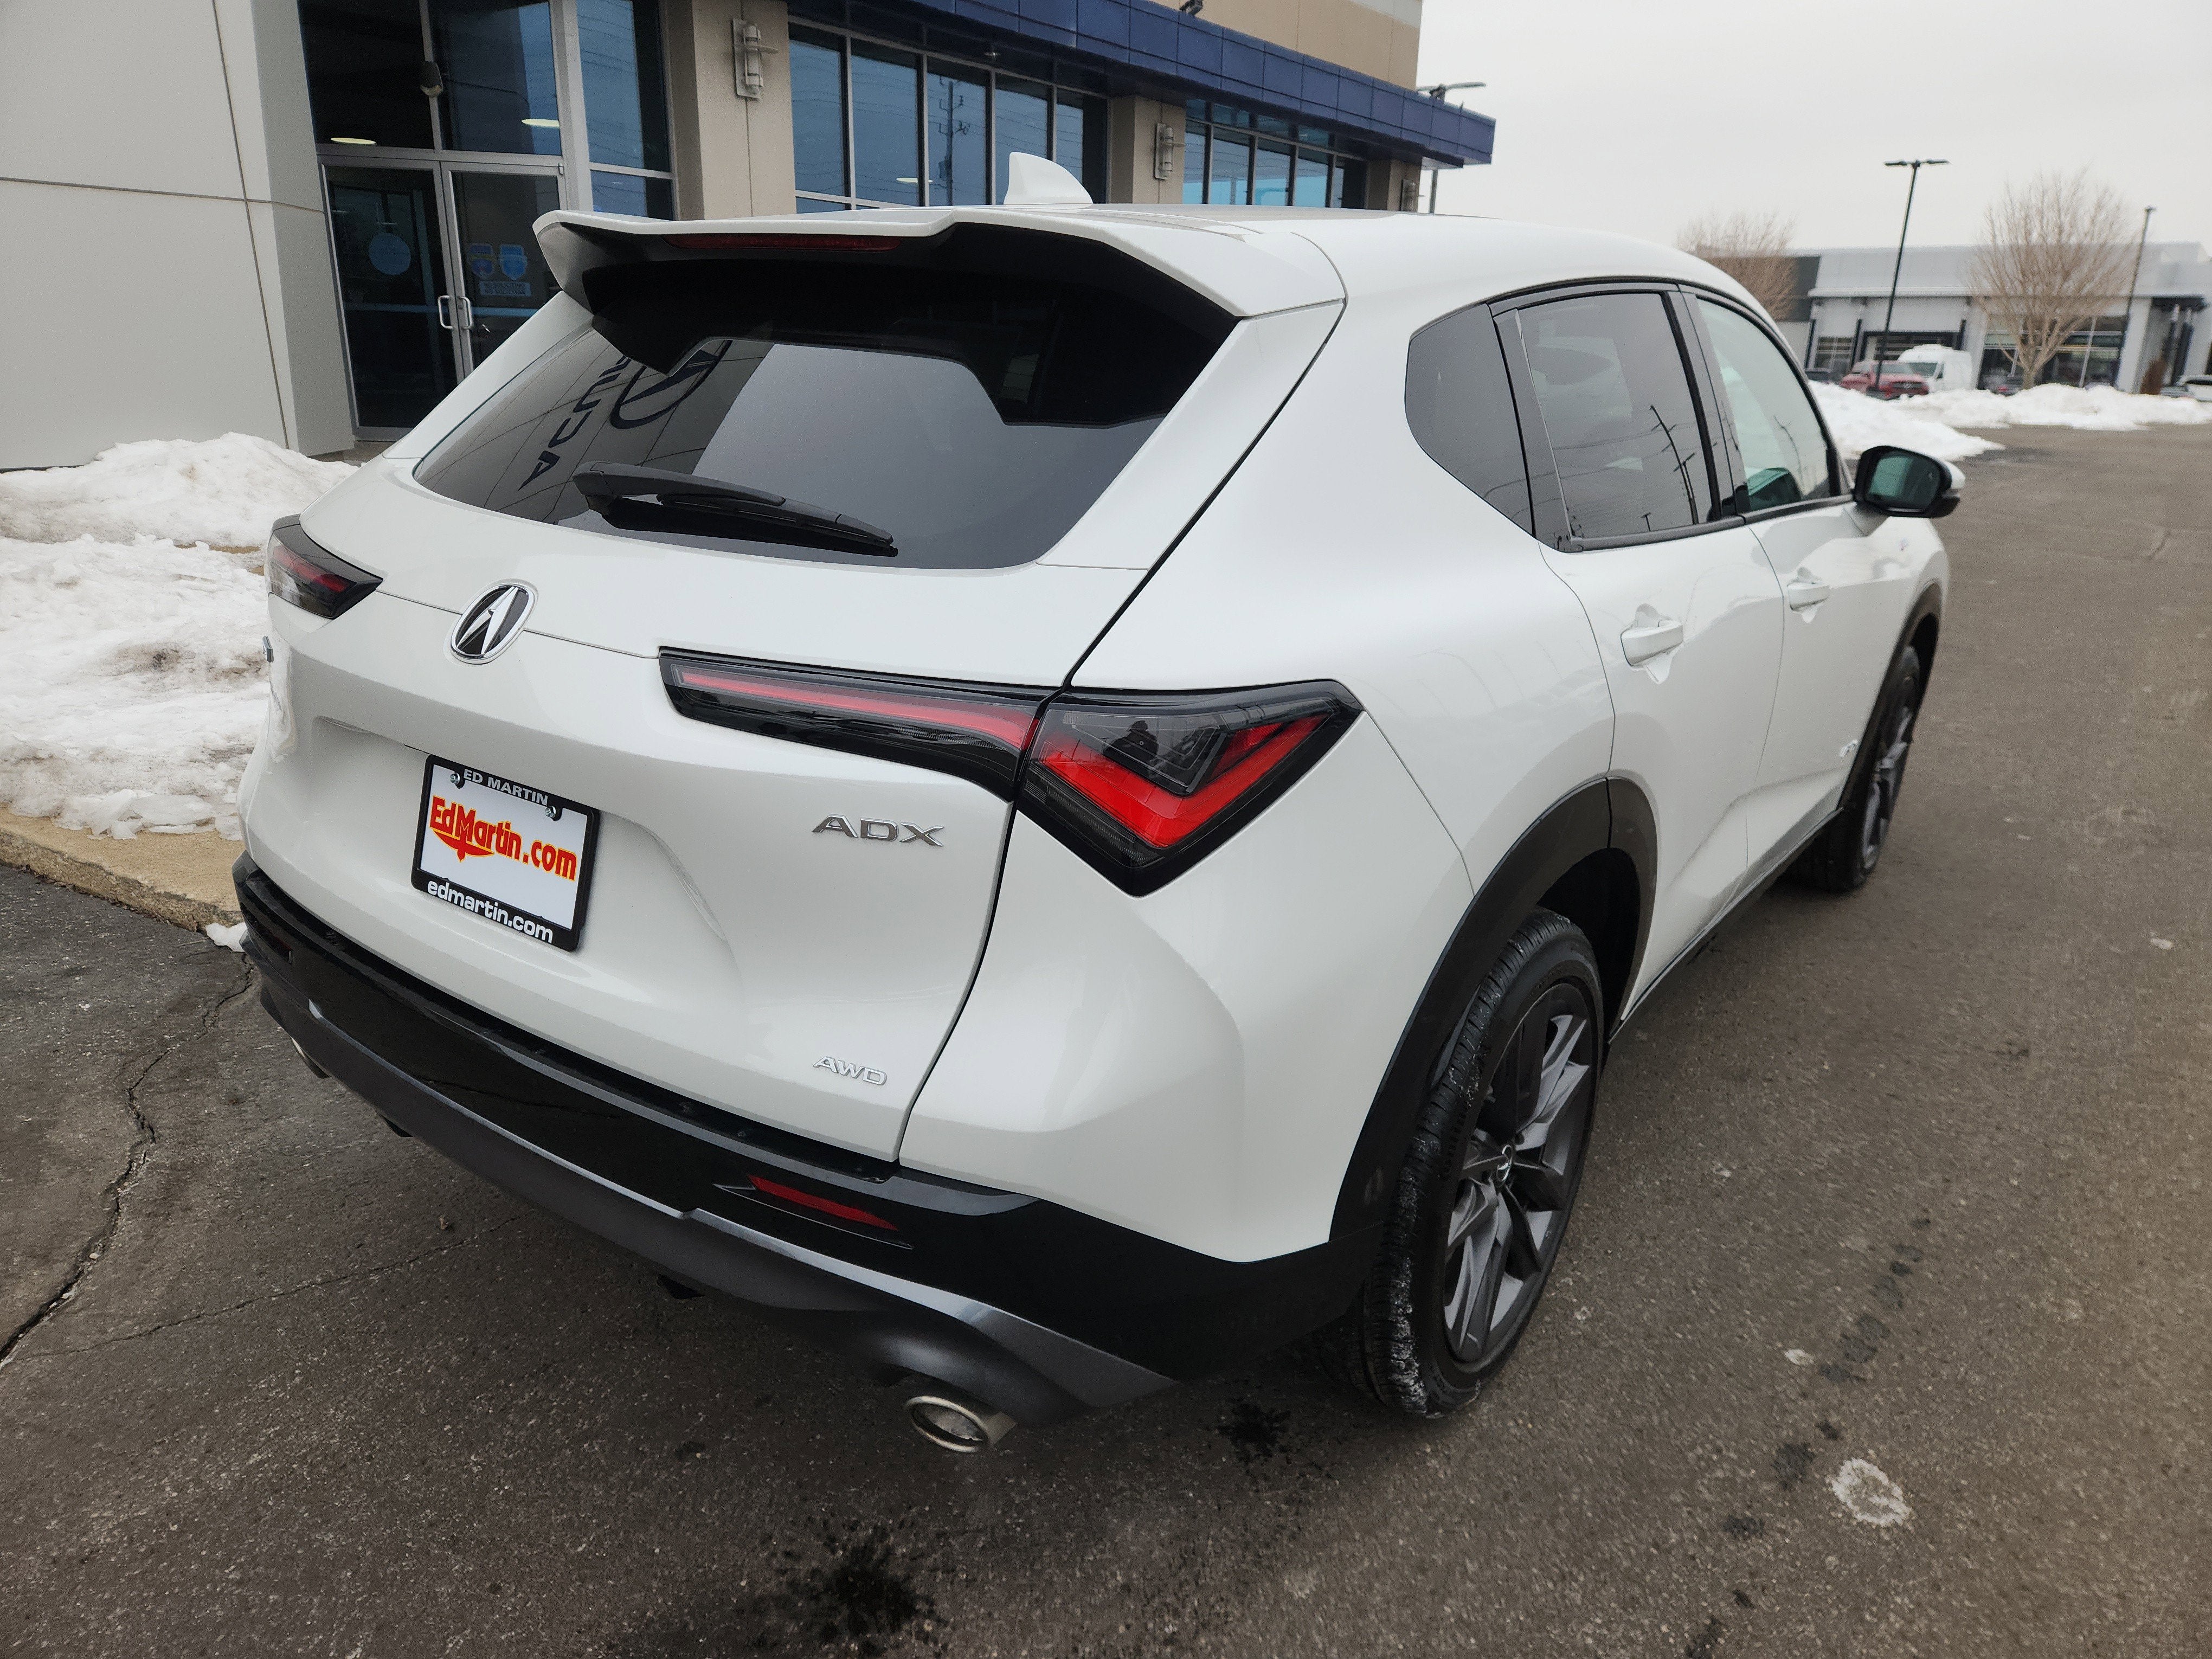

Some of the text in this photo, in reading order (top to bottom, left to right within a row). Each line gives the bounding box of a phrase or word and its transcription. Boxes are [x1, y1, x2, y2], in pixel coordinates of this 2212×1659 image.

[464, 769, 549, 806] ED MARTIN
[429, 795, 577, 881] EdMartin.com
[812, 814, 944, 846] ADX
[427, 880, 553, 943] edmartin.com
[813, 1057, 888, 1085] AWD
